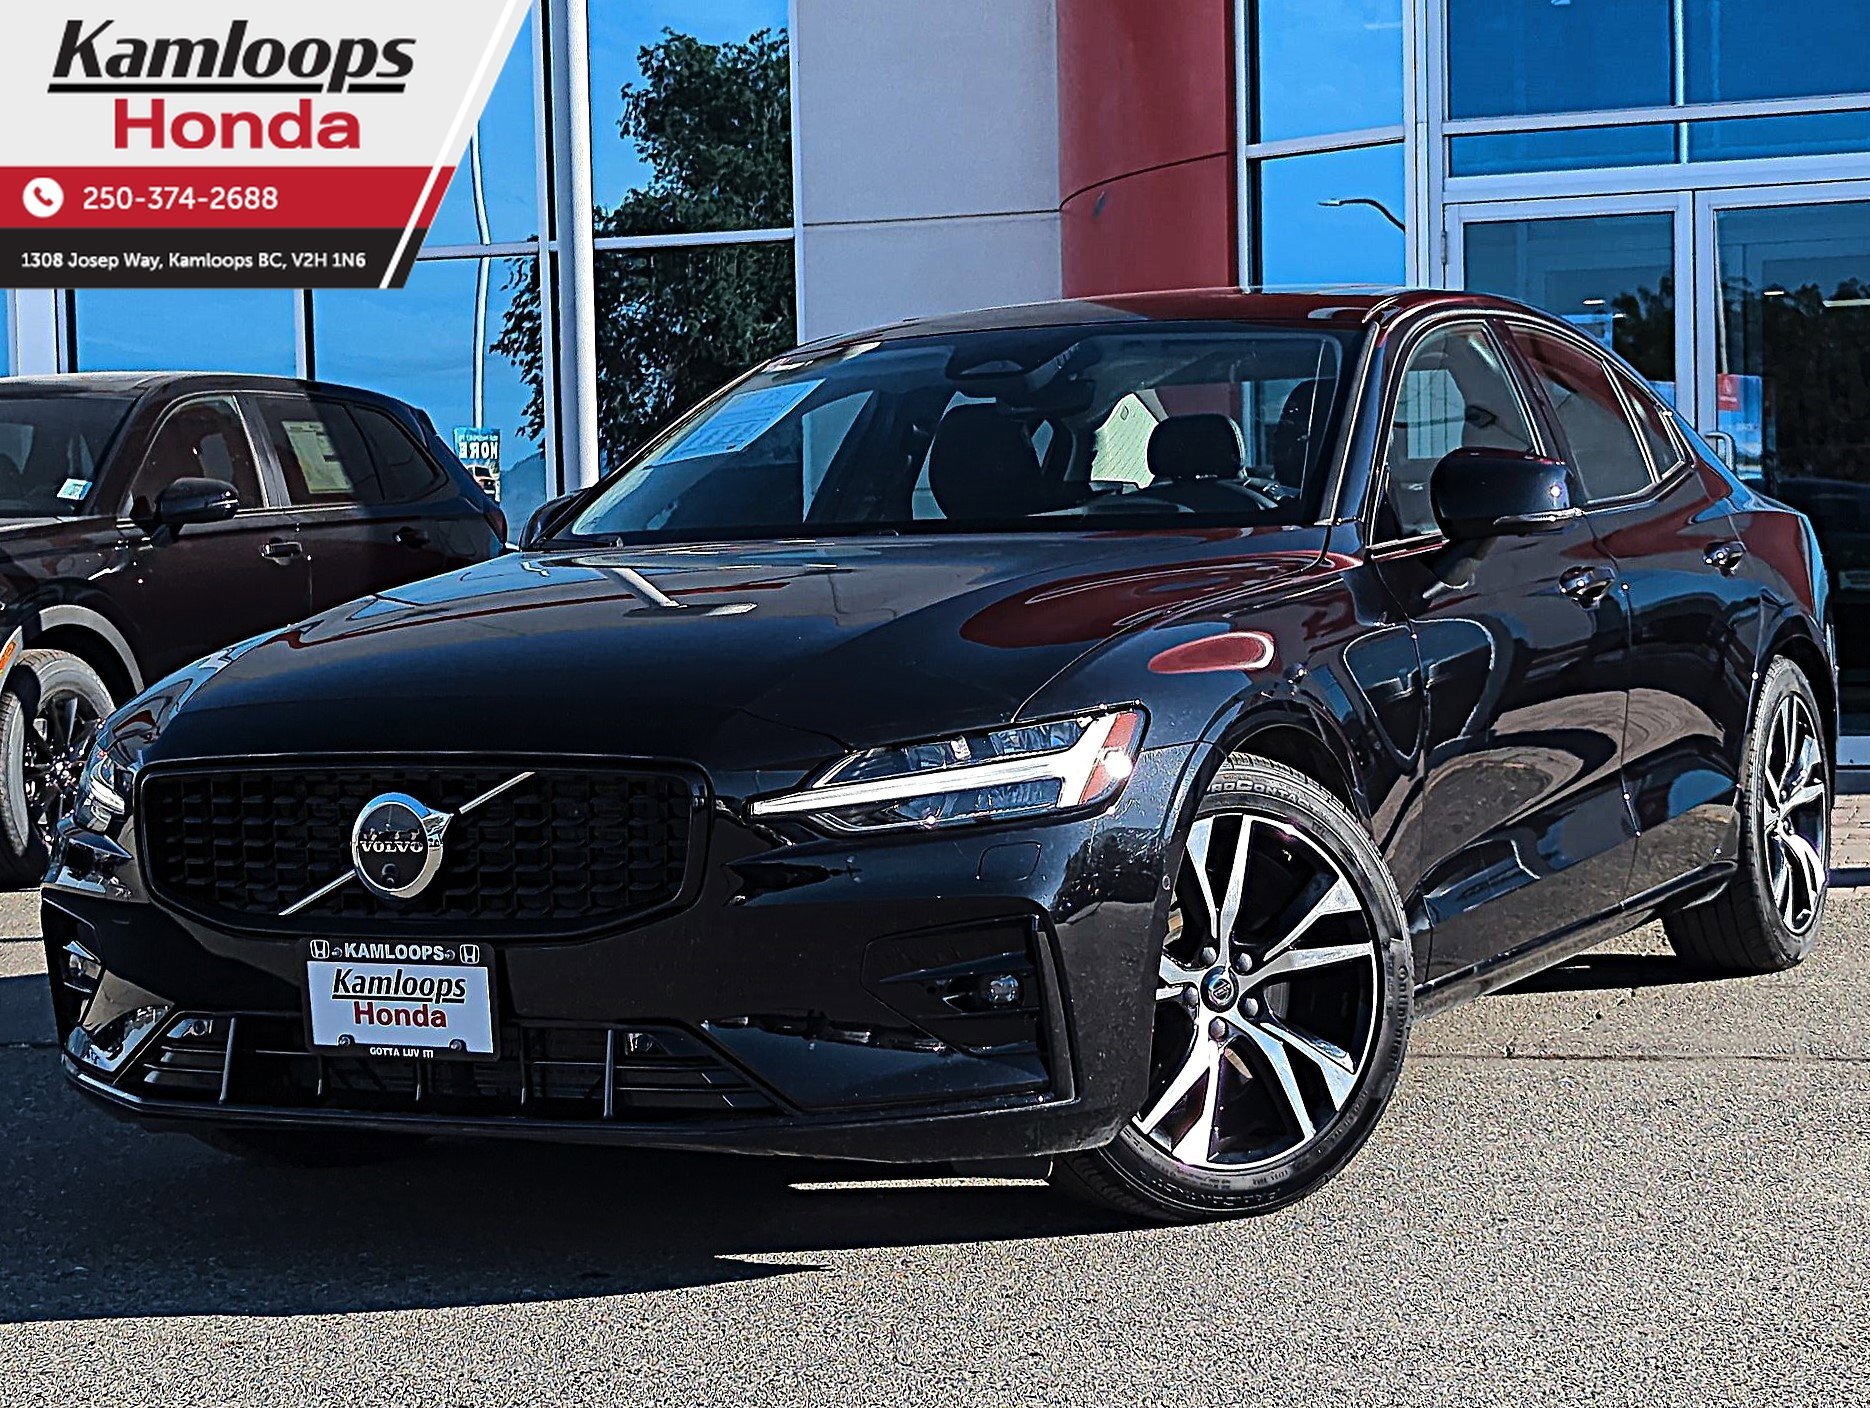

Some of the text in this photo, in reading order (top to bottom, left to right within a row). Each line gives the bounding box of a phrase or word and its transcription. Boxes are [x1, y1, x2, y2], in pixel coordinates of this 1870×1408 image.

[359, 840, 424, 853] VOLVO
[344, 942, 444, 961] KAMLOOPS
[332, 968, 466, 1004] Kamloops
[353, 1001, 448, 1028] Honda
[369, 1047, 400, 1057] GOTTA
[402, 1048, 419, 1058] LUV
